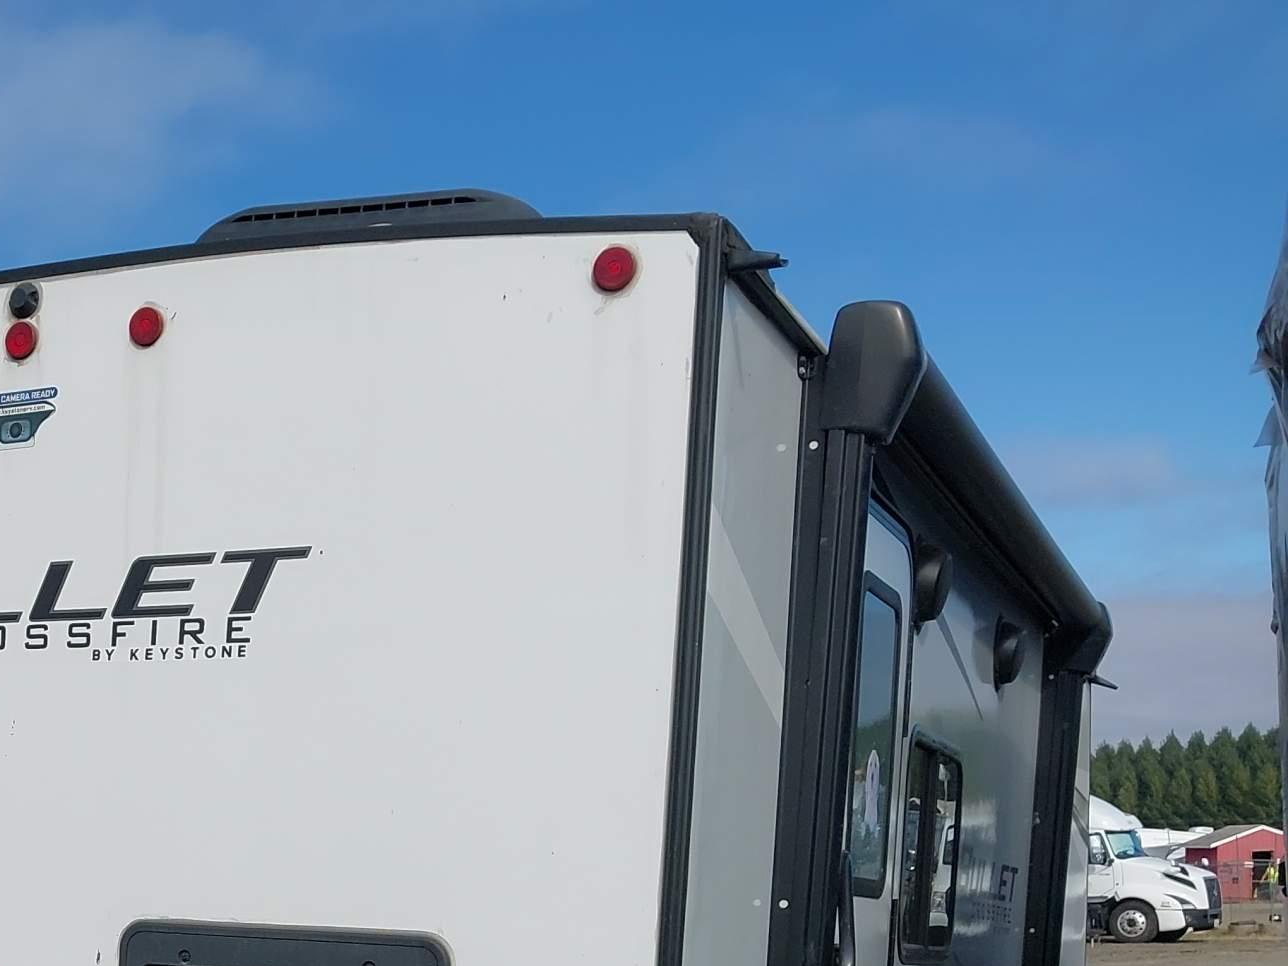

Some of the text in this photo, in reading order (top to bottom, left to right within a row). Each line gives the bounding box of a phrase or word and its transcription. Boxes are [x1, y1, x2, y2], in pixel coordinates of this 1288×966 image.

[1, 388, 56, 403] CAMERA READY
[92, 644, 247, 662] BY KEYSTONE
